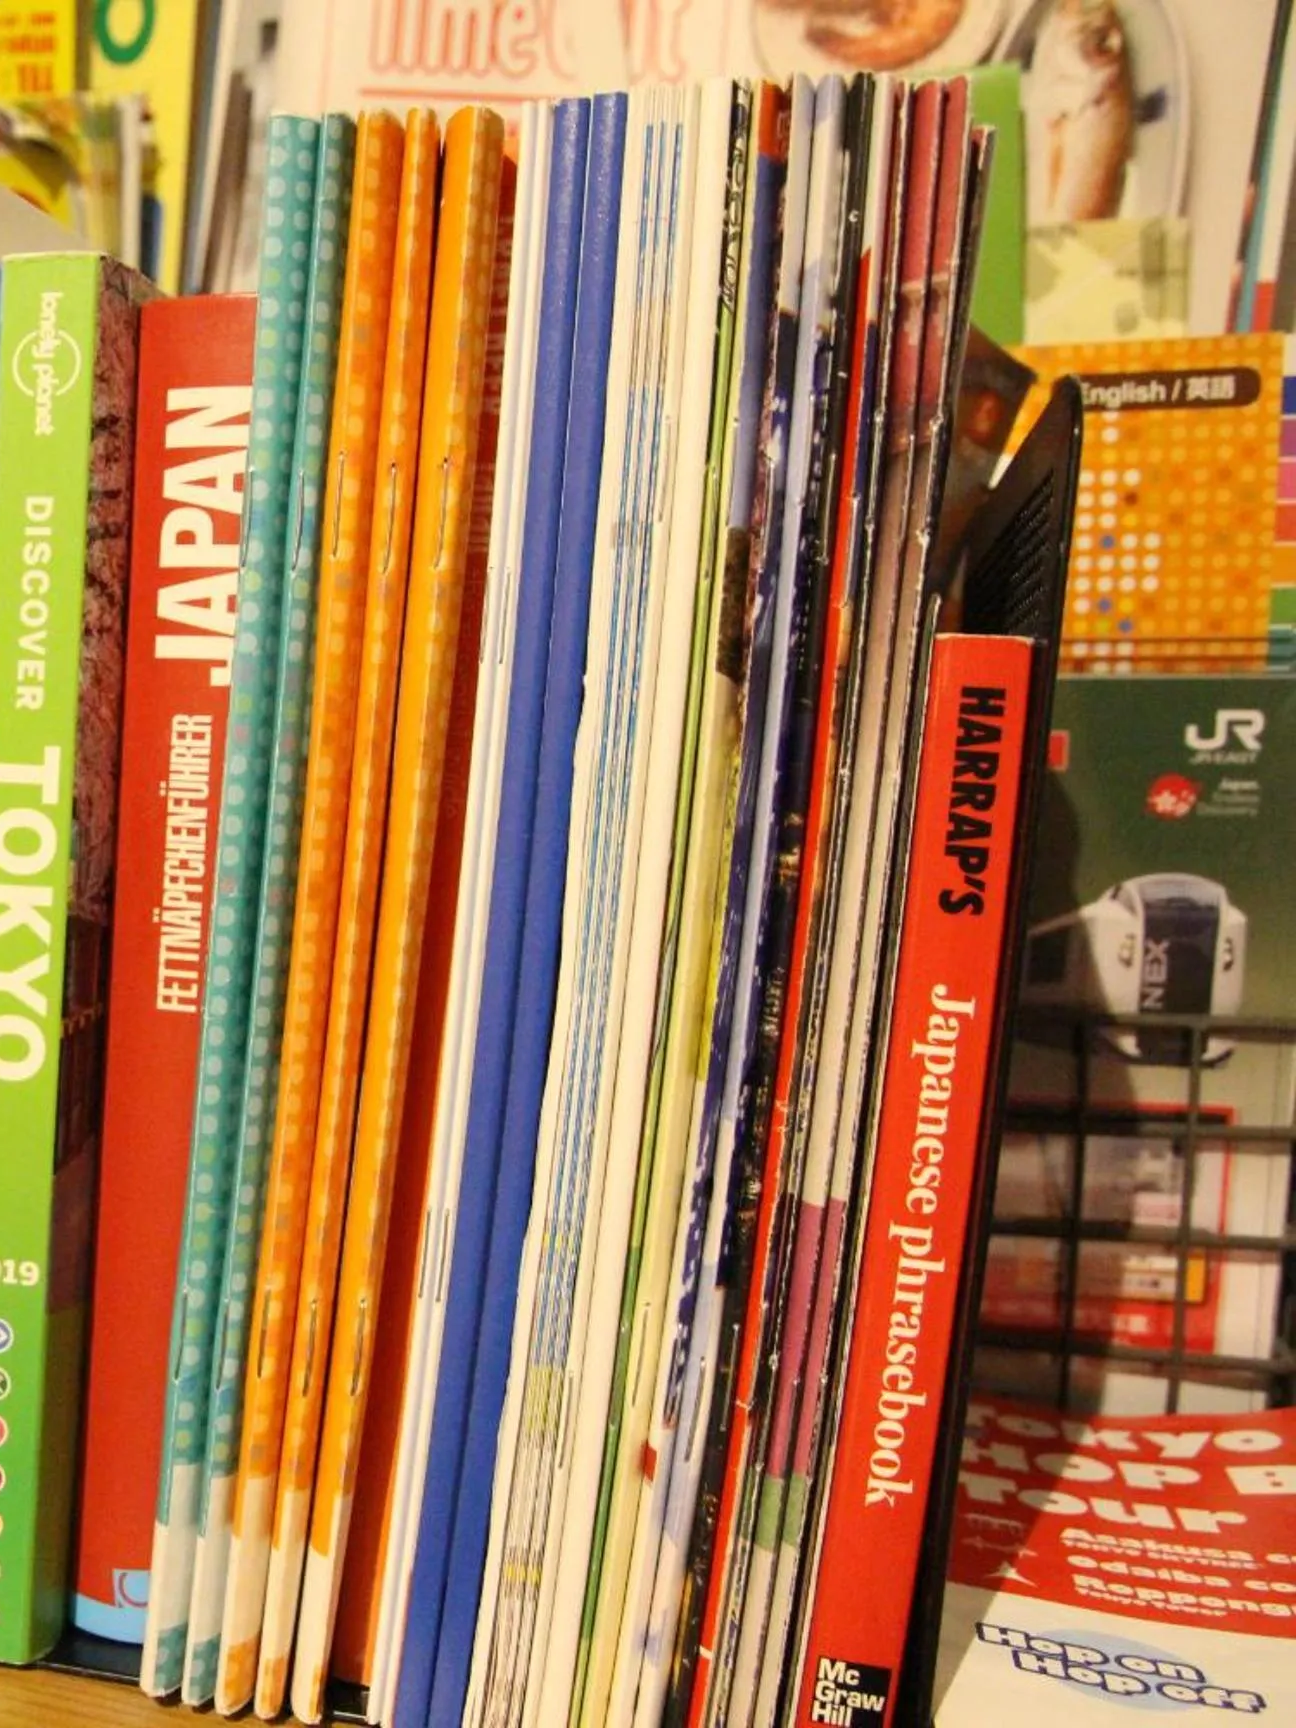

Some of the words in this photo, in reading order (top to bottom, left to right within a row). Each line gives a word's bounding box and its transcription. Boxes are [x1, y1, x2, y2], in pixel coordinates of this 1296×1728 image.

[32, 290, 65, 360] lonely
[32, 360, 60, 438] planet
[154, 385, 253, 689] JAPAN
[15, 495, 55, 711] DISCOVER
[1185, 708, 1265, 752] JR
[937, 684, 1008, 918] HARRAP'S
[151, 714, 214, 1015] FETTNÄPFCHENFÜHRER
[905, 983, 976, 1216] Japanese
[864, 1220, 947, 1509] phrasebook
[956, 1470, 1249, 1535] Tour
[1059, 1527, 1255, 1562] Asakusa
[1067, 1555, 1232, 1588] Odaiba
[817, 1657, 861, 1686] Mc
[975, 1621, 1110, 1666] Hop
[1113, 1653, 1207, 1684] on
[1011, 1648, 1151, 1697] Hop
[1155, 1681, 1267, 1715] off
[811, 1699, 853, 1728] Hill
[814, 1679, 886, 1713] Graw
